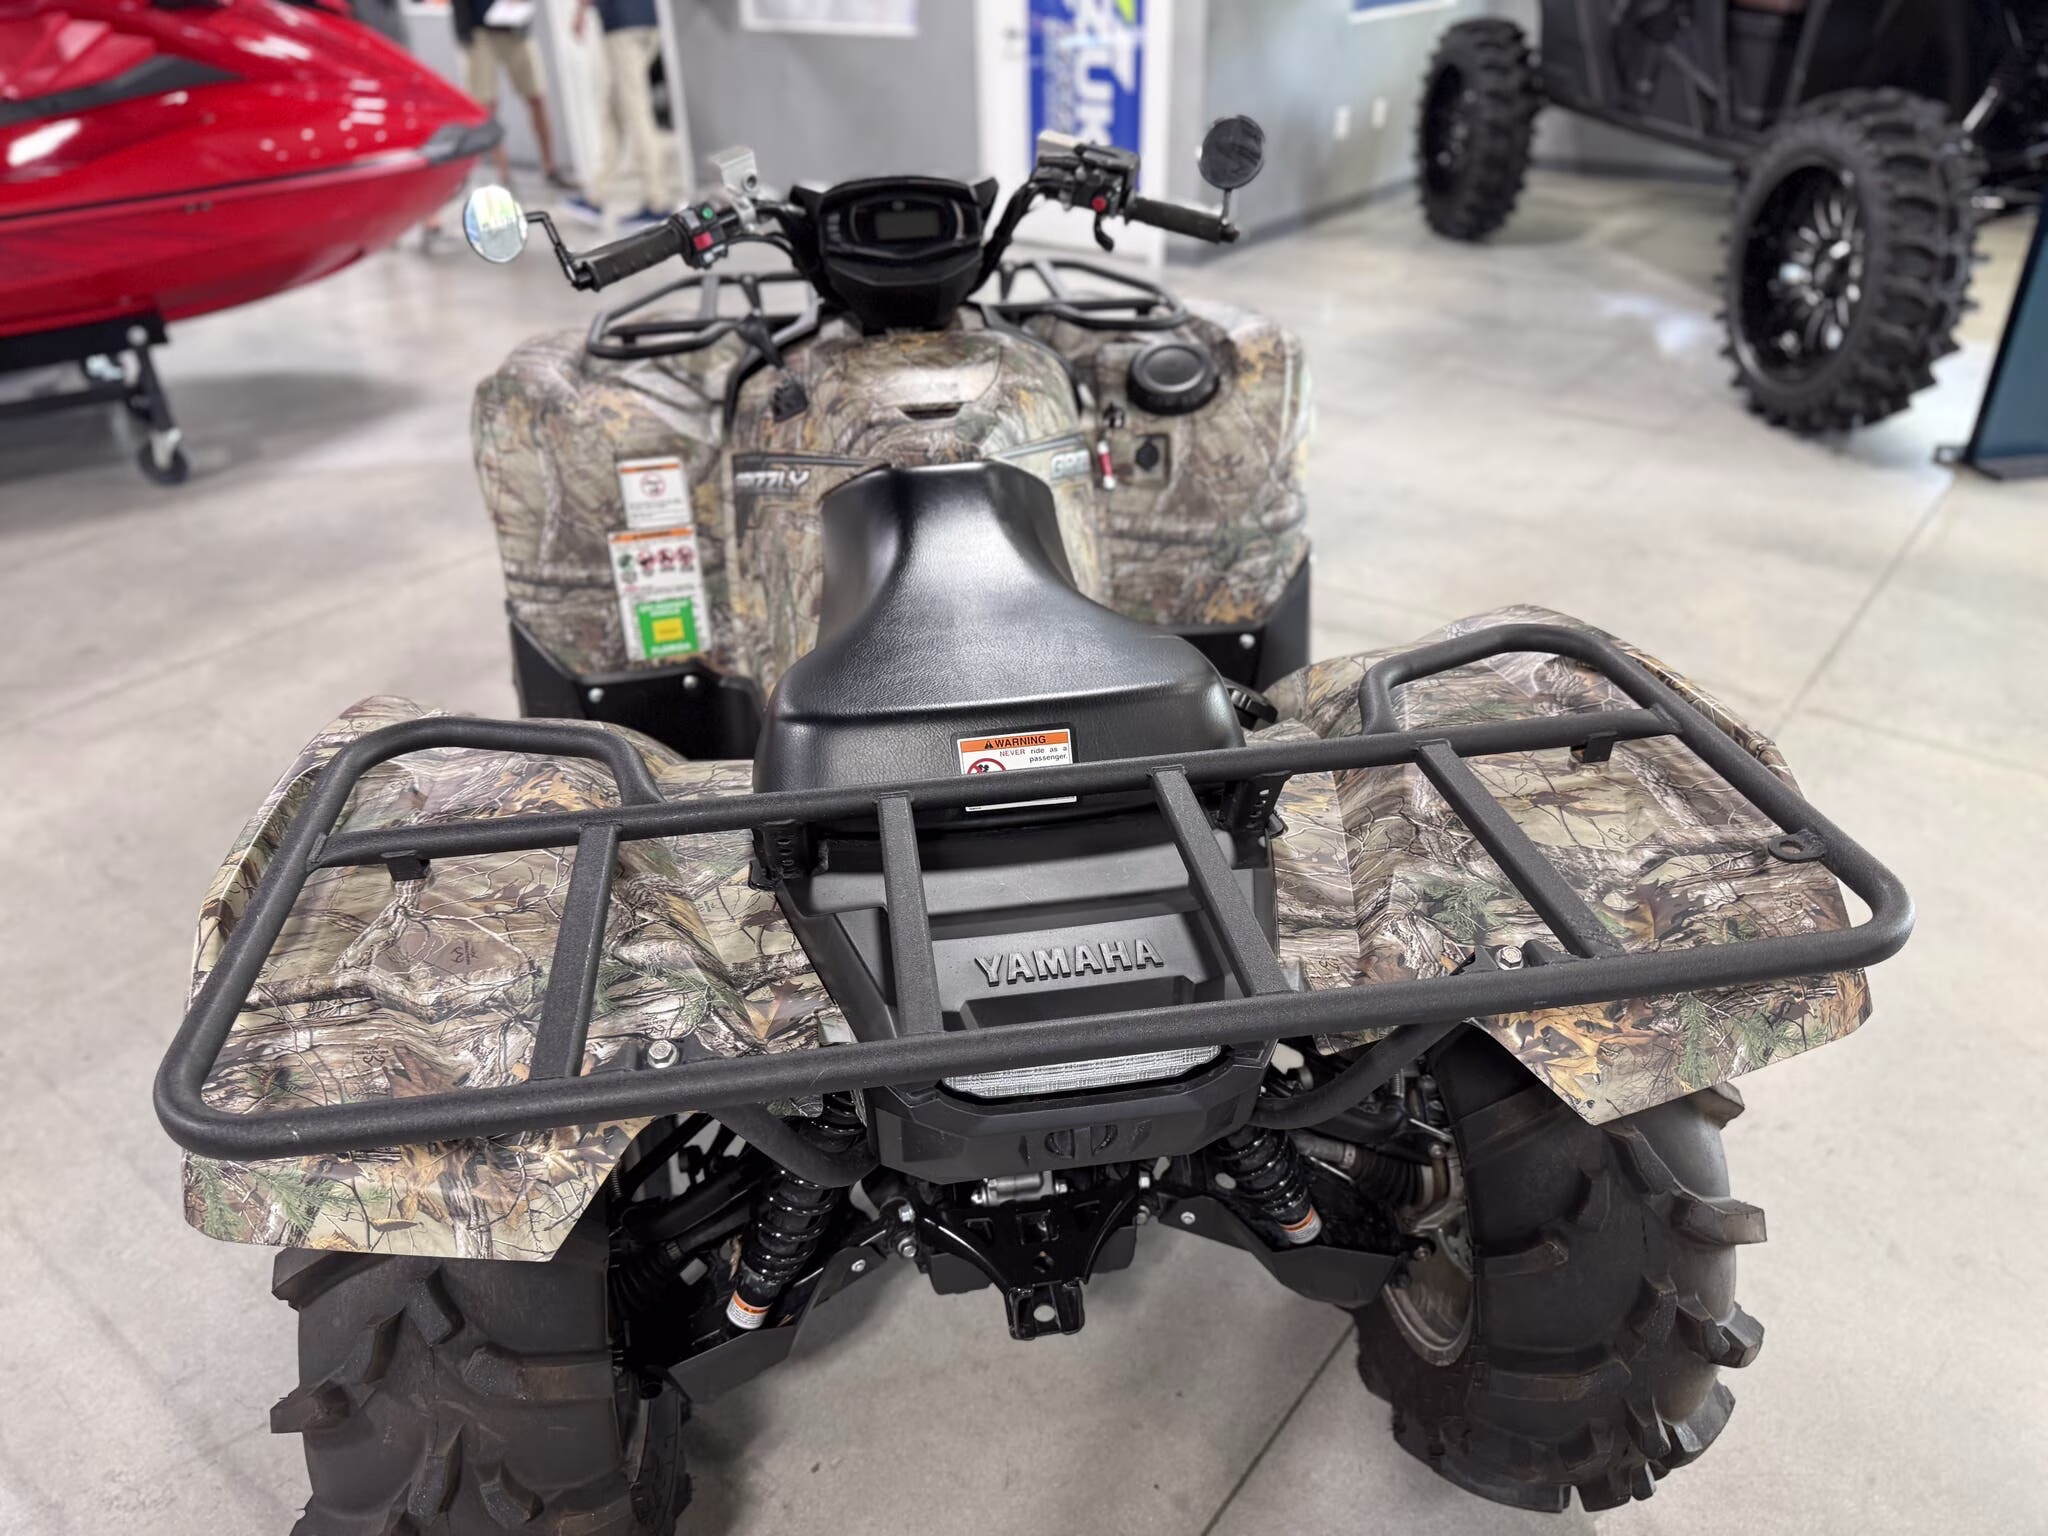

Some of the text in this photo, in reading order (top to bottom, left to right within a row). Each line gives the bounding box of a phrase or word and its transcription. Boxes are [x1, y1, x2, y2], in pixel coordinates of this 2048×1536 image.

[995, 735, 1047, 748] WARNING
[999, 748, 1026, 757] NEVER
[1030, 747, 1045, 755] ride
[1029, 753, 1068, 763] passenger.
[974, 936, 1165, 988] YAMAHA
